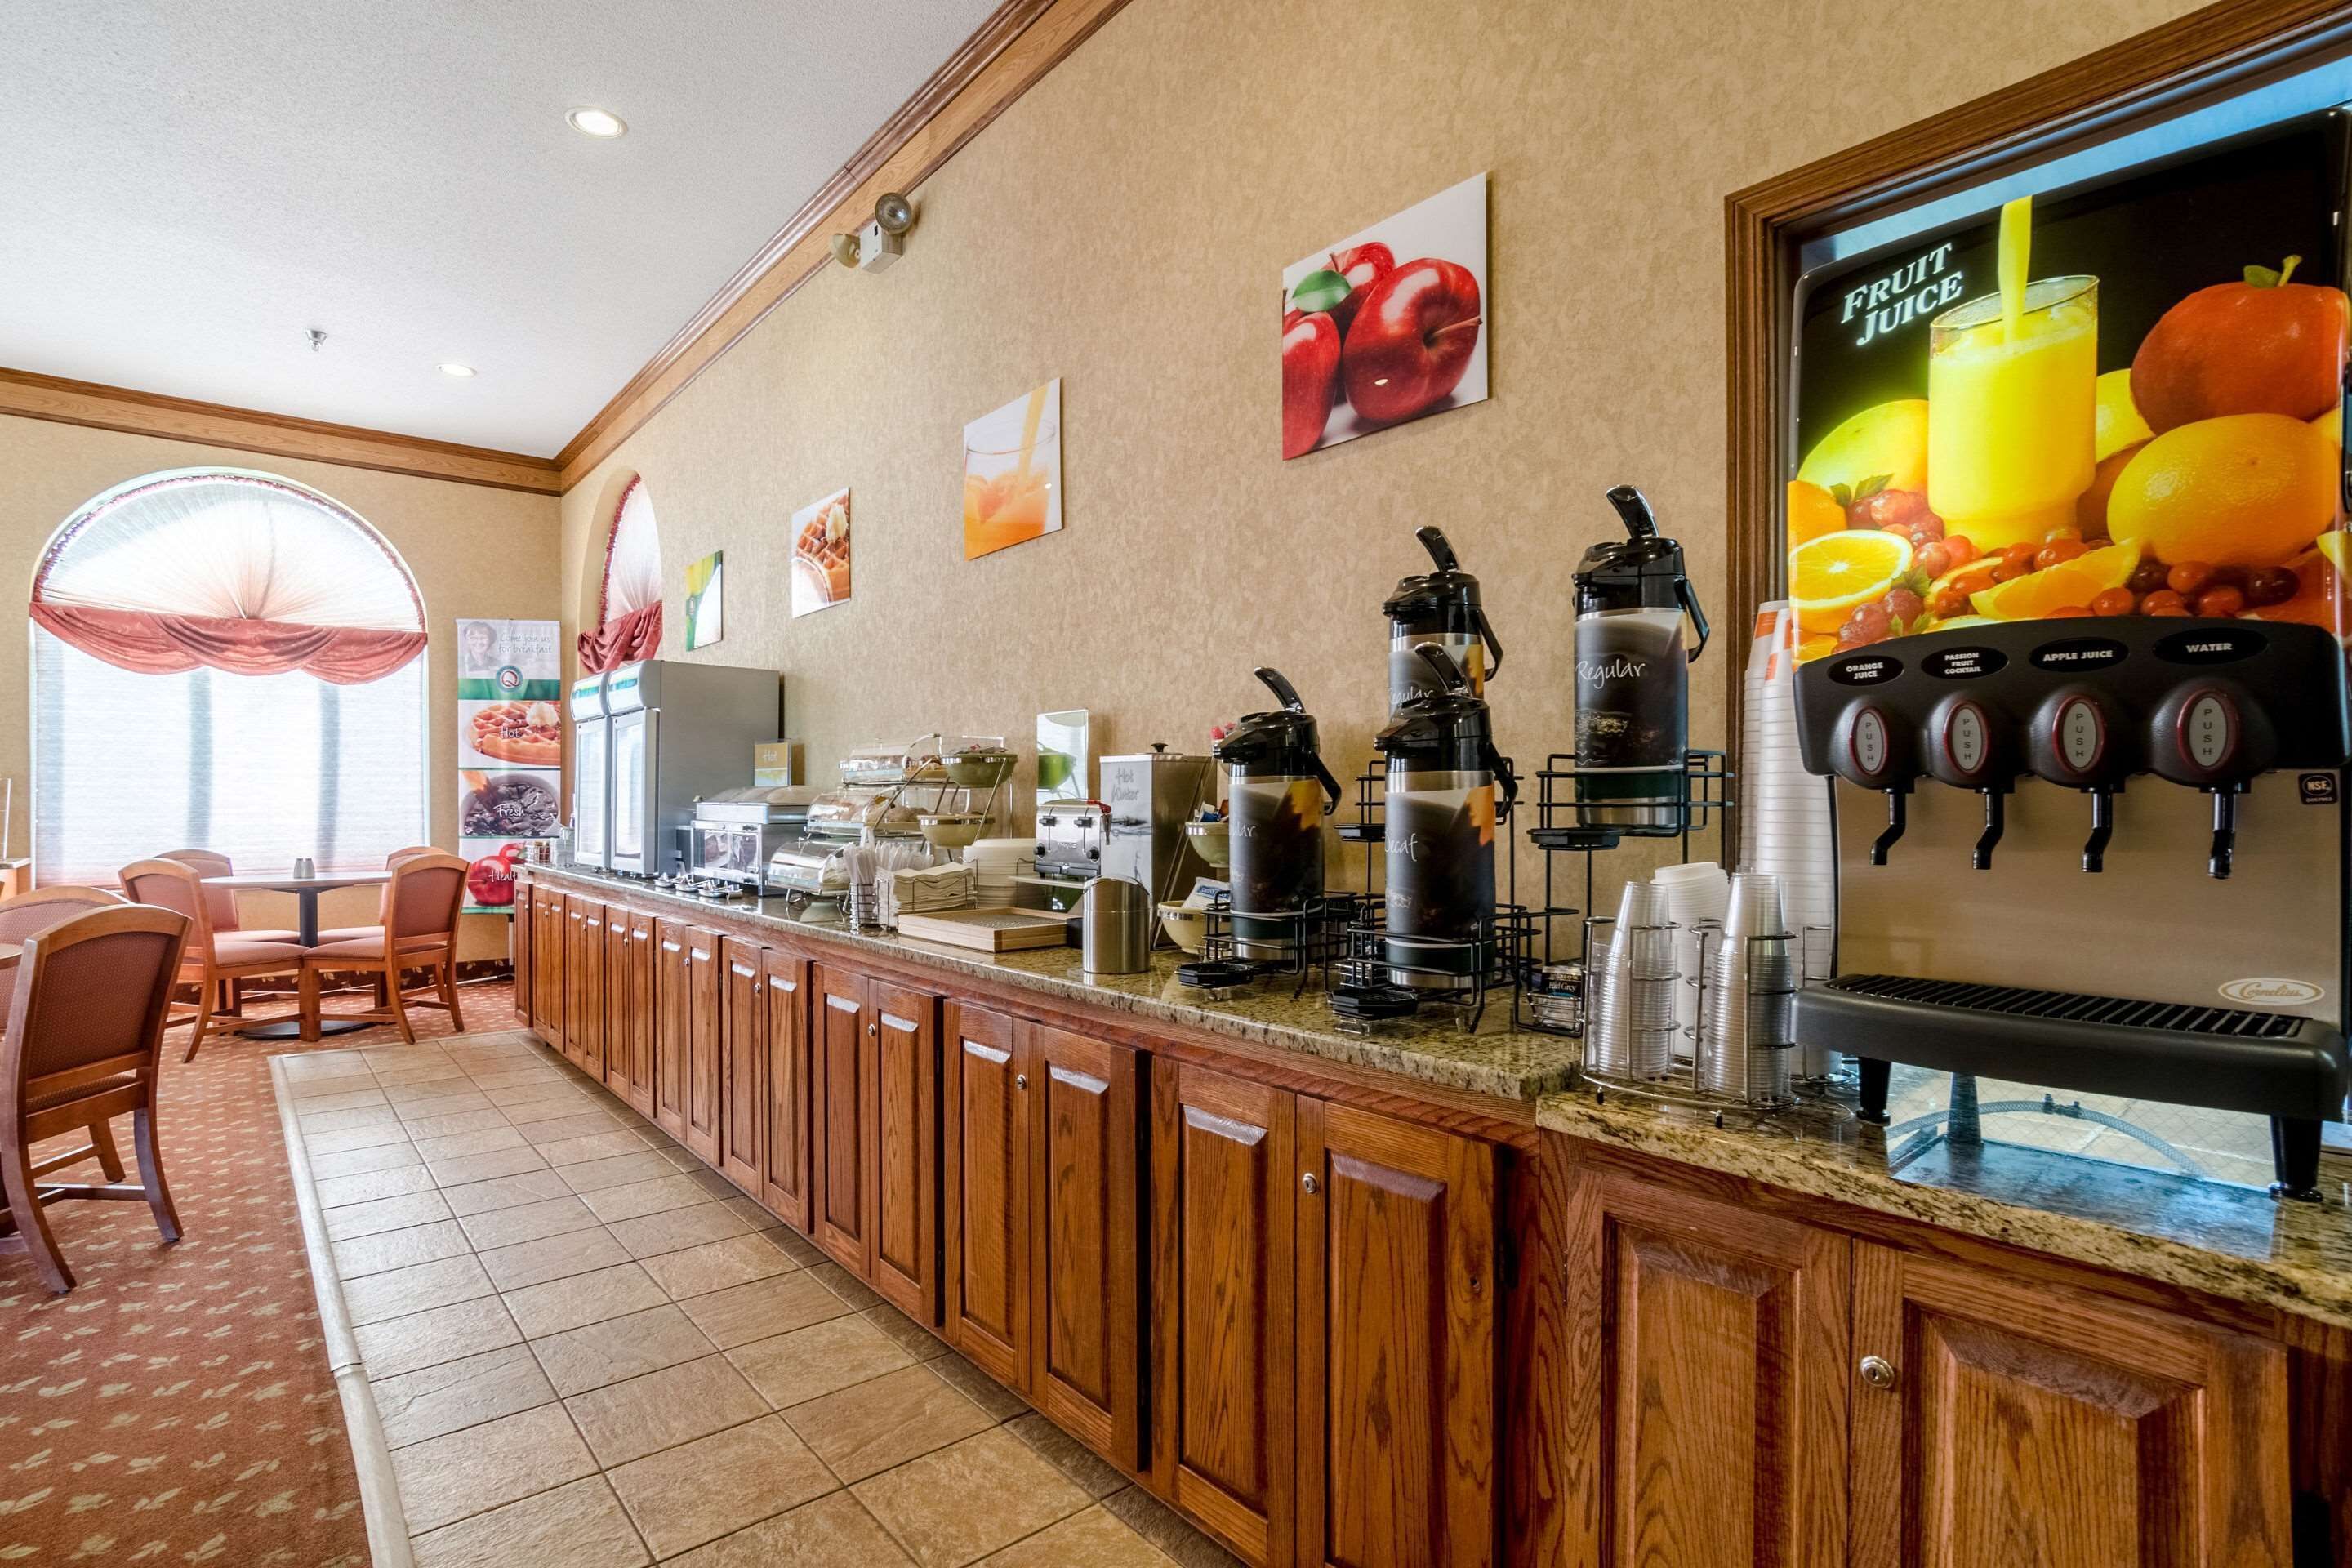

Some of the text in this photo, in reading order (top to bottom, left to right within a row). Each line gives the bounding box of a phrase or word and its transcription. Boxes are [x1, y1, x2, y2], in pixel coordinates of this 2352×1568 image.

[1841, 242, 1953, 324] FRUIT
[1855, 270, 1962, 346] JUICE
[2185, 642, 2233, 653] WATER
[1944, 652, 1980, 662] PASSION
[1951, 659, 1975, 667] FRUIT
[2042, 650, 2114, 662] APPLE JUICE
[1575, 658, 1646, 689] Regular
[1846, 662, 1884, 673] ORANGE
[1944, 666, 1982, 675] COCKTAIL
[1853, 670, 1878, 680] JUICE
[501, 726, 521, 739] Hot
[1962, 718, 1971, 760] PUSH
[2075, 713, 2084, 757] PUSH
[2202, 708, 2212, 756] PUSH
[1864, 722, 1874, 762] PUSH
[1116, 767, 1134, 784] Hot
[2307, 780, 2328, 791] NSF
[1111, 784, 1140, 802] Water
[492, 803, 524, 817] Fresh
[1561, 982, 1575, 992] Grey
[2239, 982, 2302, 1000] Cornelius
